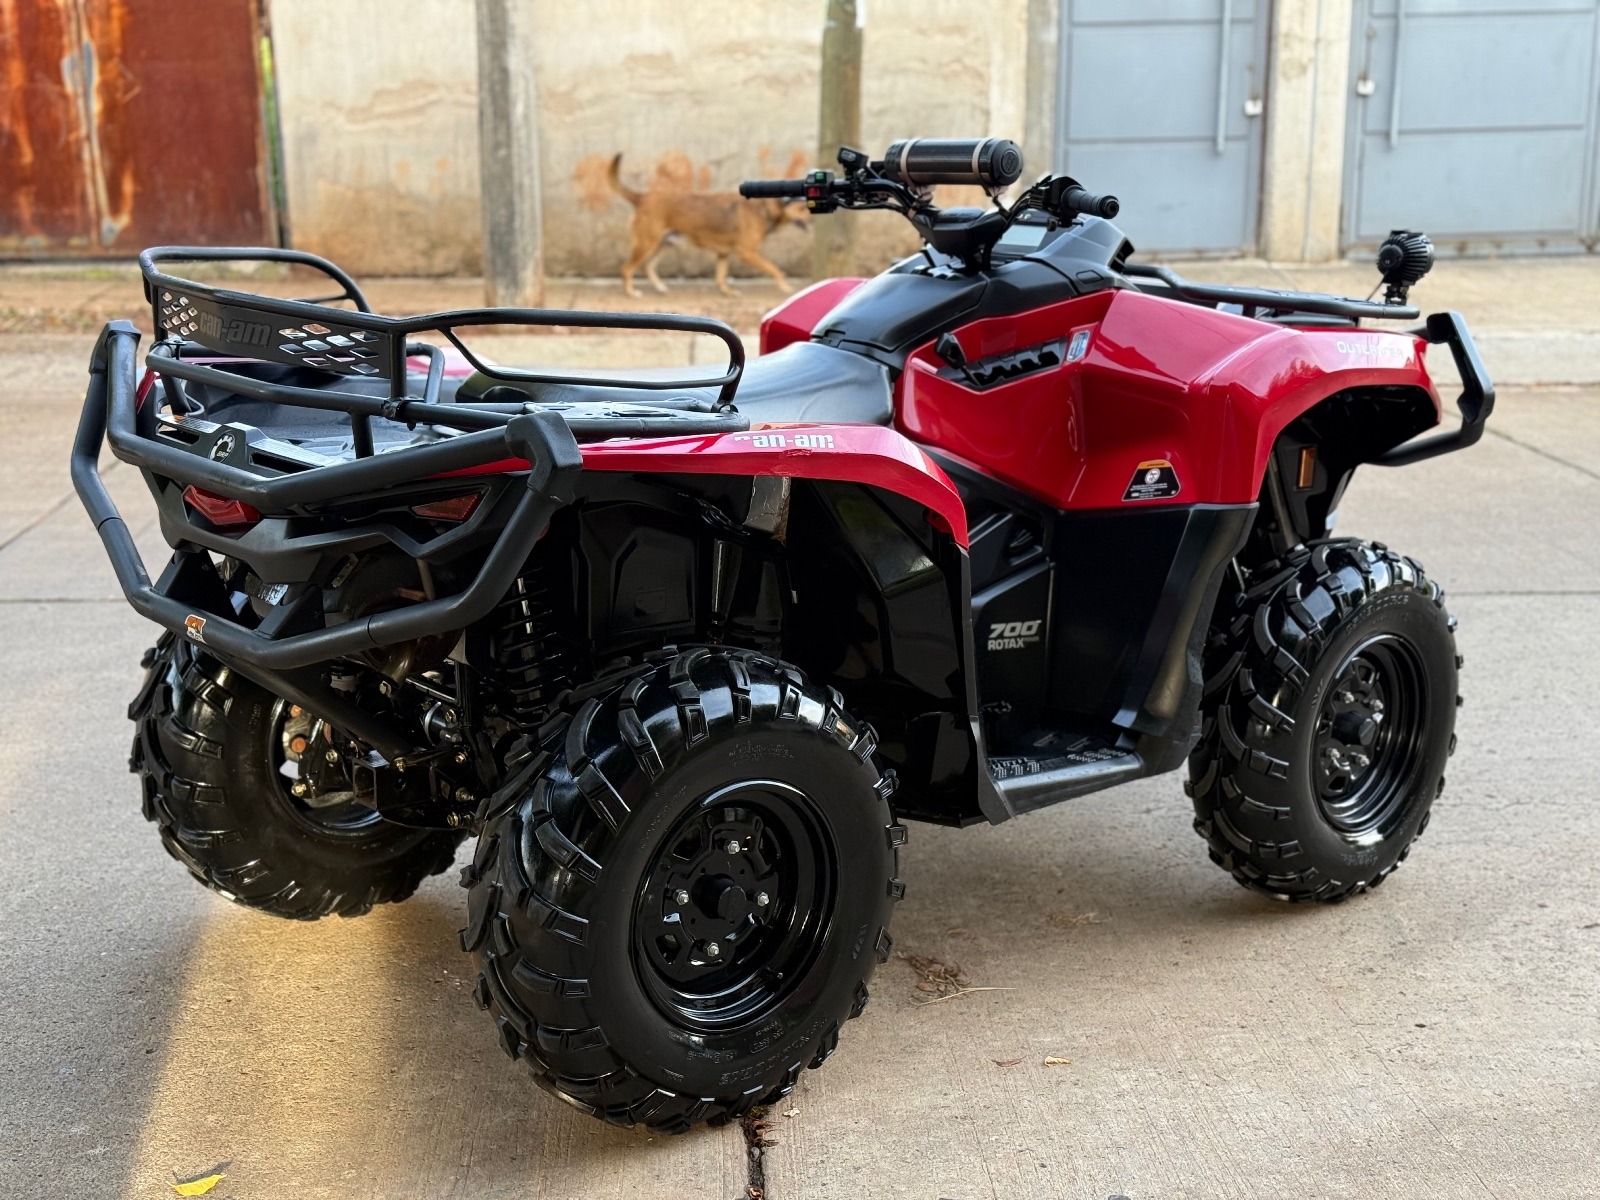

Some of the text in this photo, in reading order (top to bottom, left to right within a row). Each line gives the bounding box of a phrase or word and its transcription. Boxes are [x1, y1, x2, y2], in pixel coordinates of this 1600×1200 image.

[200, 310, 272, 347] can-am
[989, 620, 1042, 639] 700
[988, 637, 1025, 651] ROTAX
